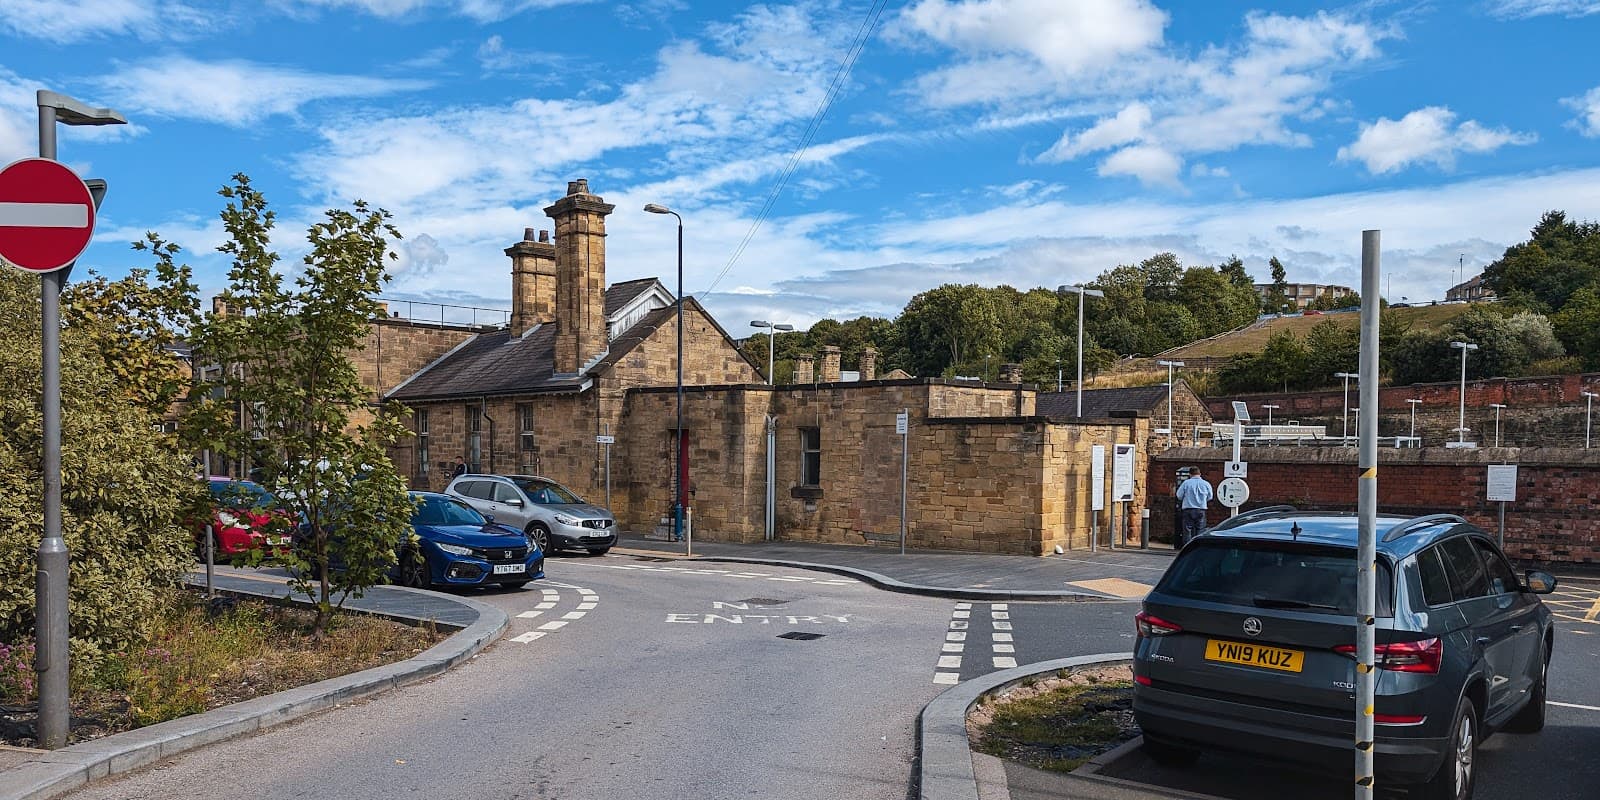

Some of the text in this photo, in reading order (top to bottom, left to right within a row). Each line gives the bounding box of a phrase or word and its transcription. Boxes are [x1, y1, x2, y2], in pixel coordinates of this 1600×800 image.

[664, 613, 853, 624] ENTRY
[1217, 643, 1293, 668] YN19 KUZ
